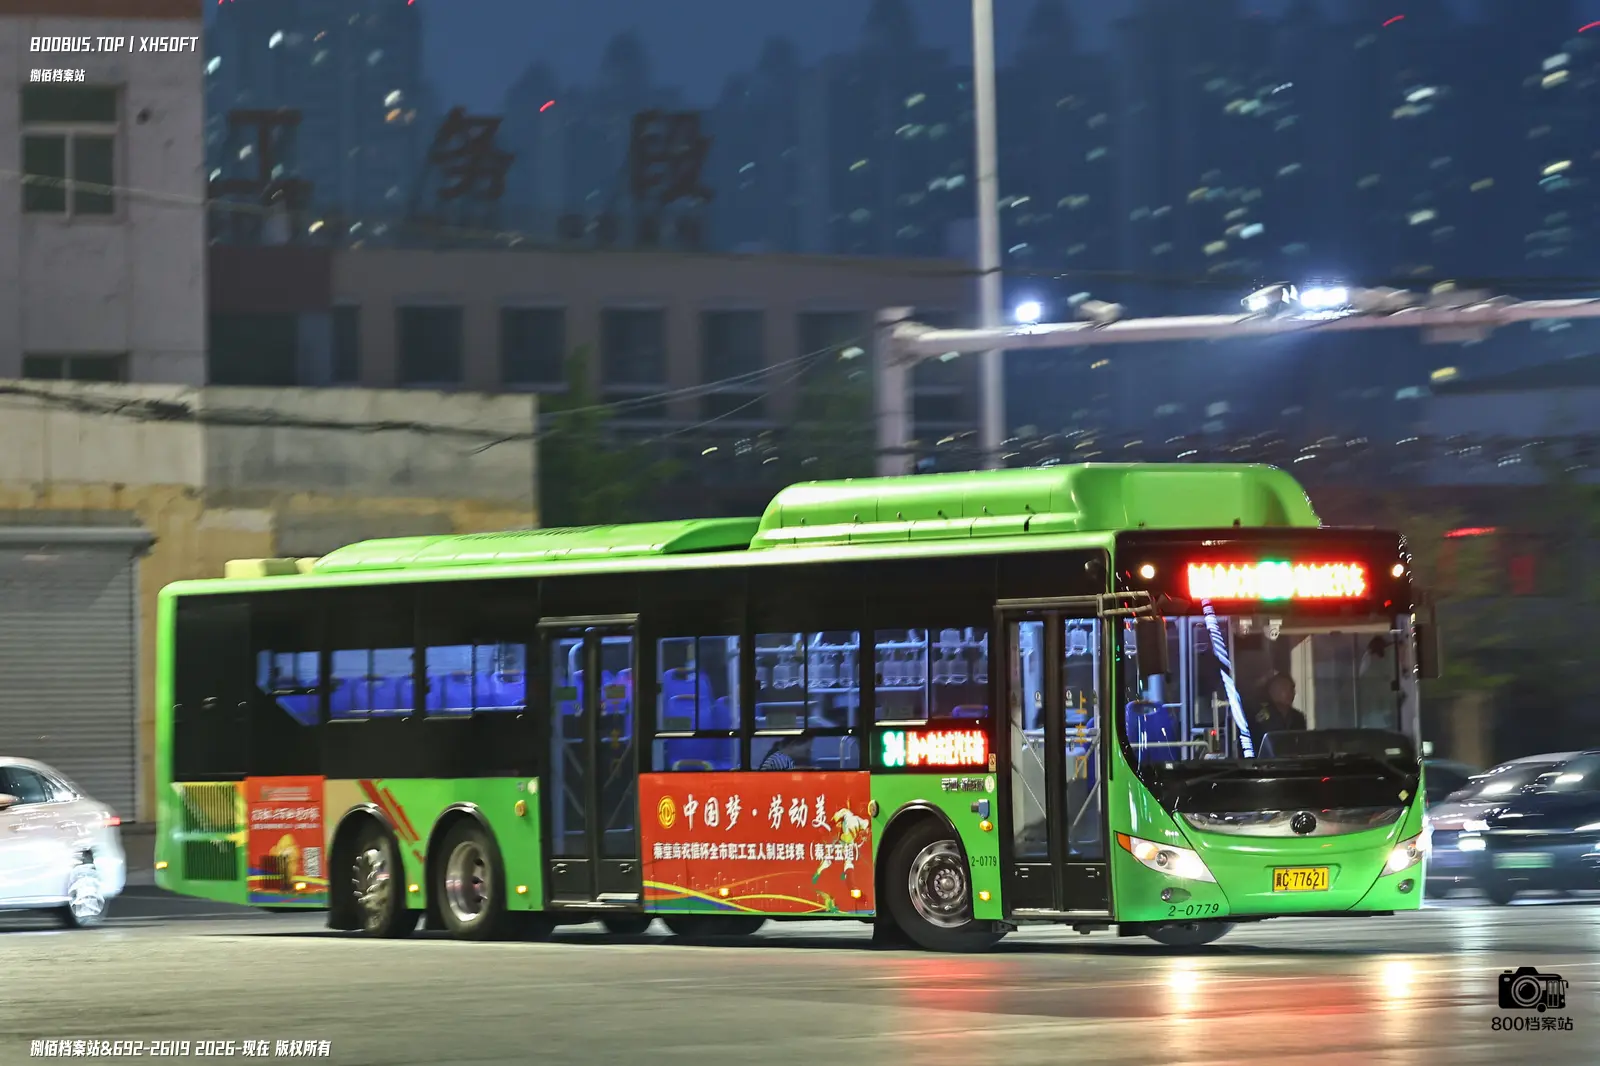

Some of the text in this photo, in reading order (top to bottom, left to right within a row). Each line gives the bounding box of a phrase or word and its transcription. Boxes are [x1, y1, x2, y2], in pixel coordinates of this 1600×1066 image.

[682, 793, 831, 832] 中国梦·劳动美
[970, 855, 997, 868] 2-0779
[1168, 903, 1220, 917] 2-0779
